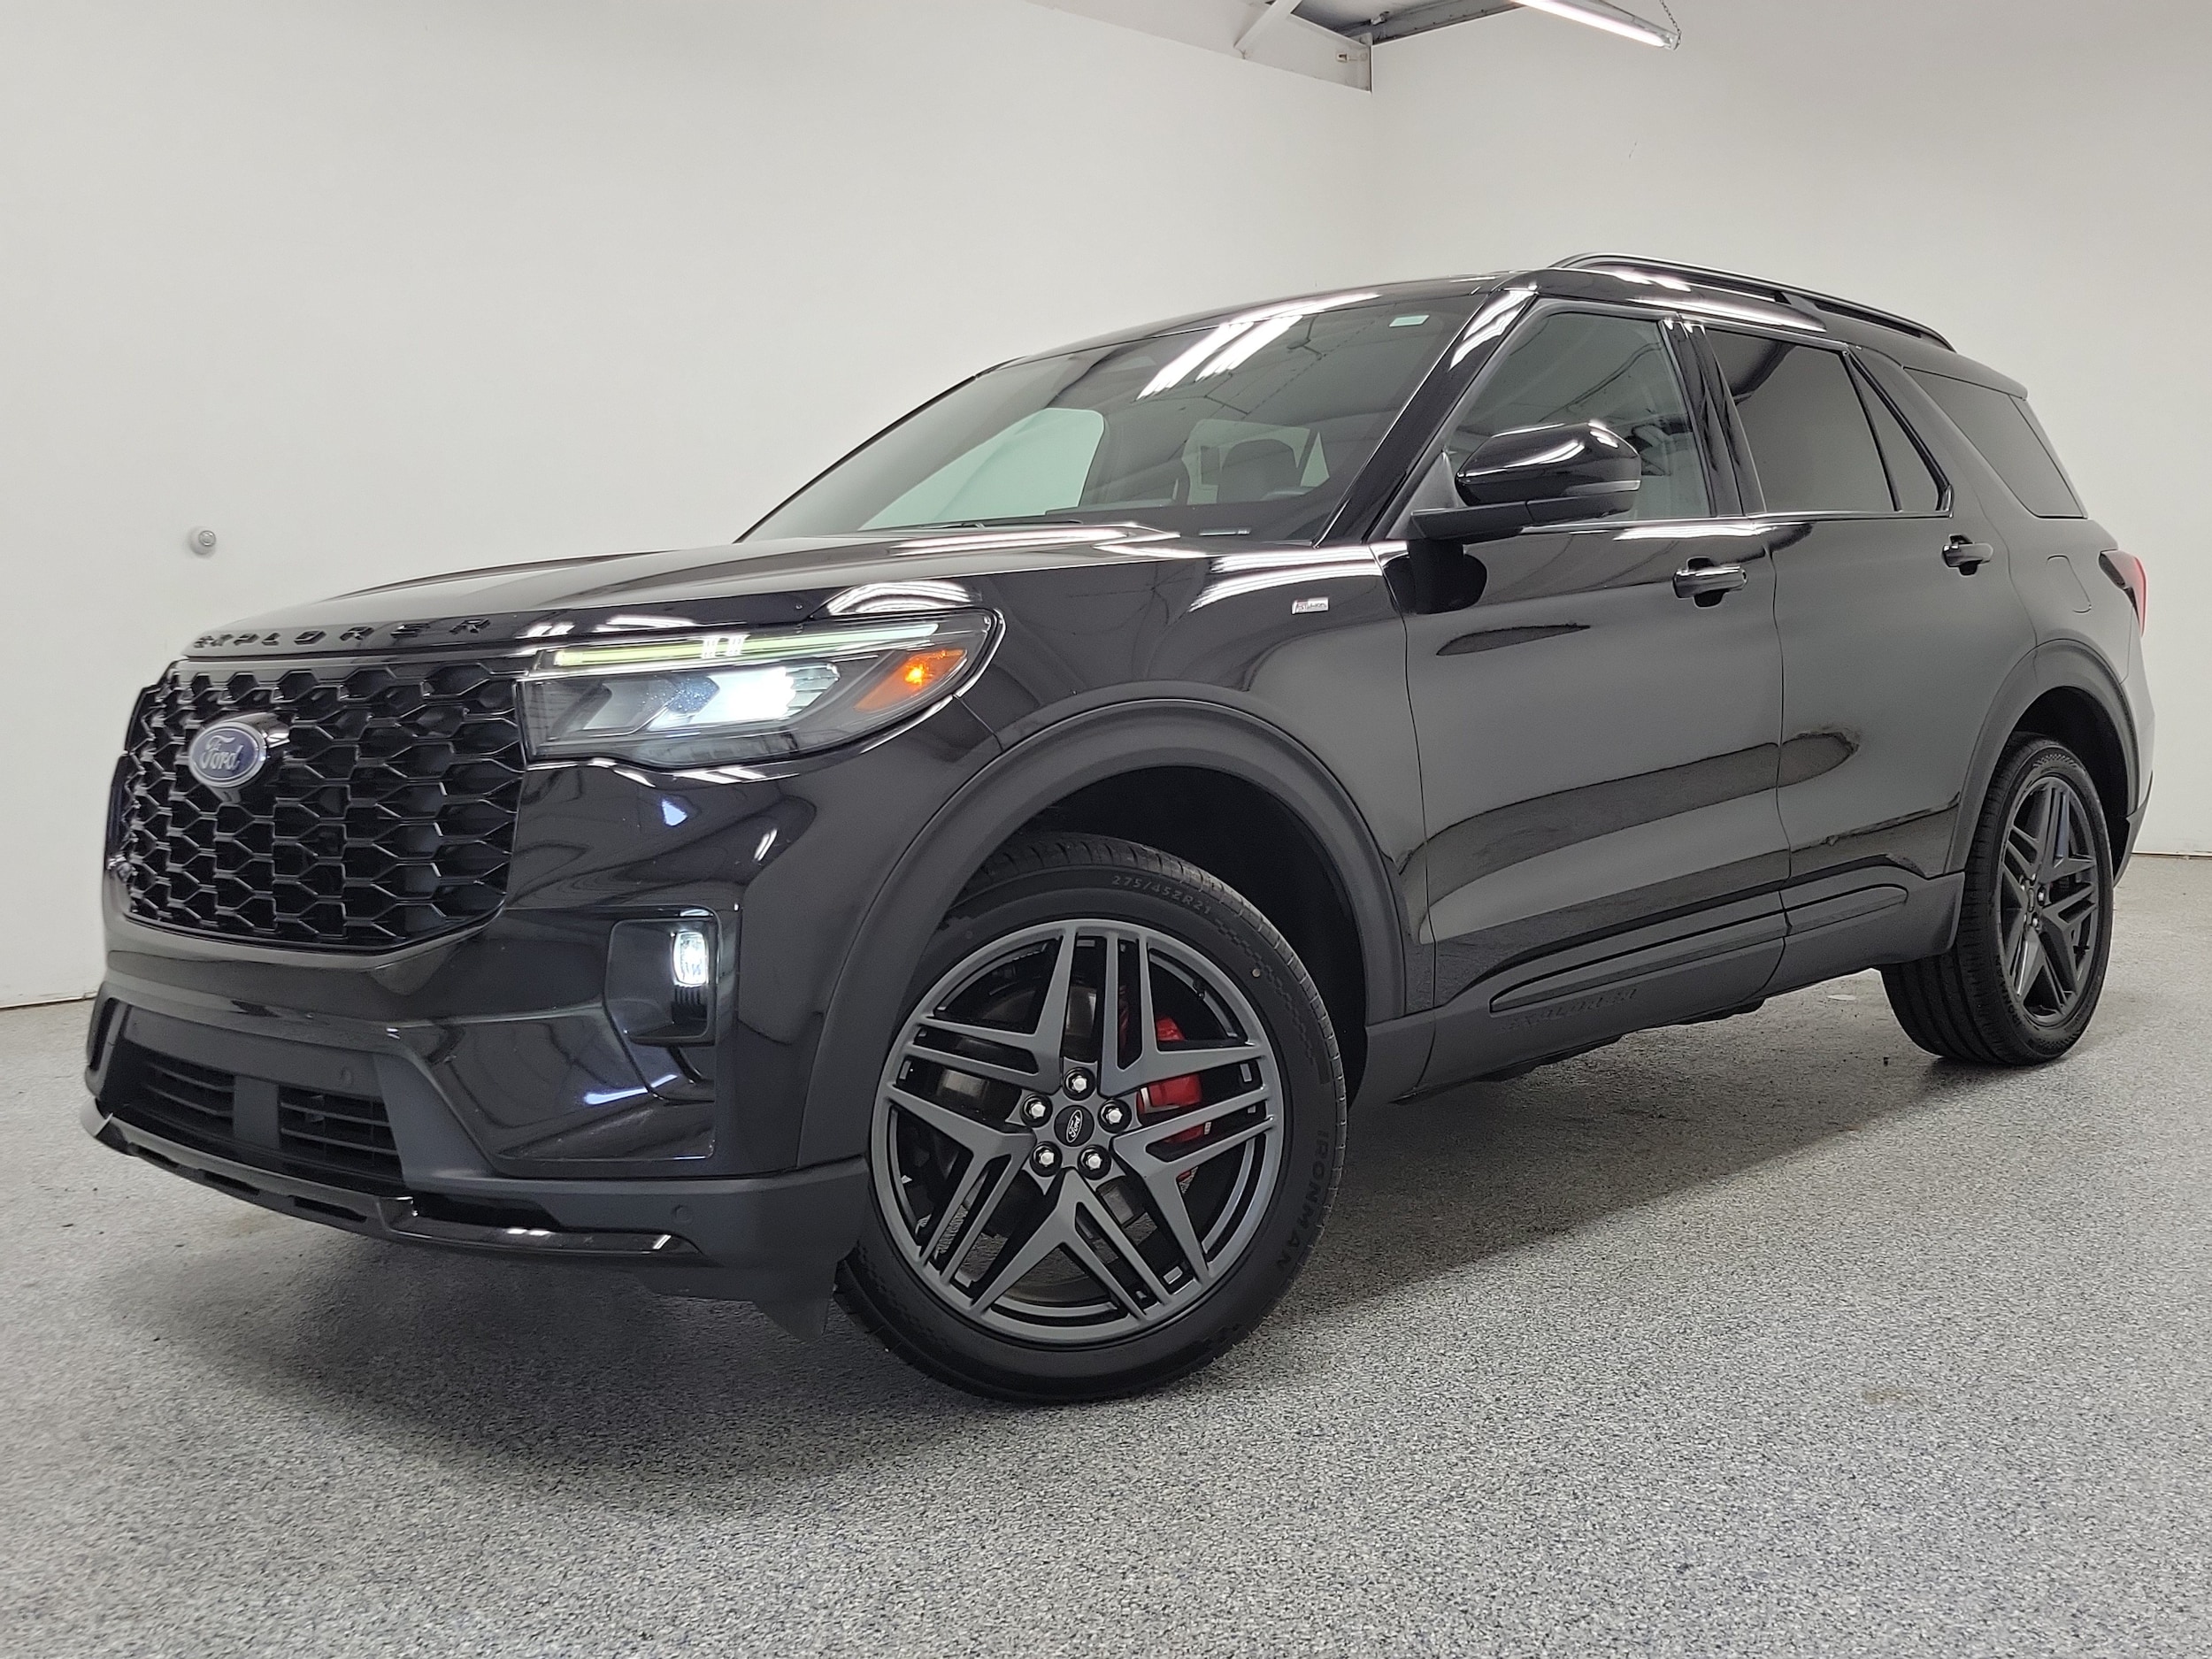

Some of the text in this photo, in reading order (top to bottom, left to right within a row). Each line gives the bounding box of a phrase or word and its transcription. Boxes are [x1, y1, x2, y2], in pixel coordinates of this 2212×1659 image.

[199, 734, 245, 771] Ford
[1111, 875, 1212, 915] 275/45ZR21
[1069, 1115, 1080, 1138] Ford
[1277, 1130, 1327, 1267] IRONMAN
